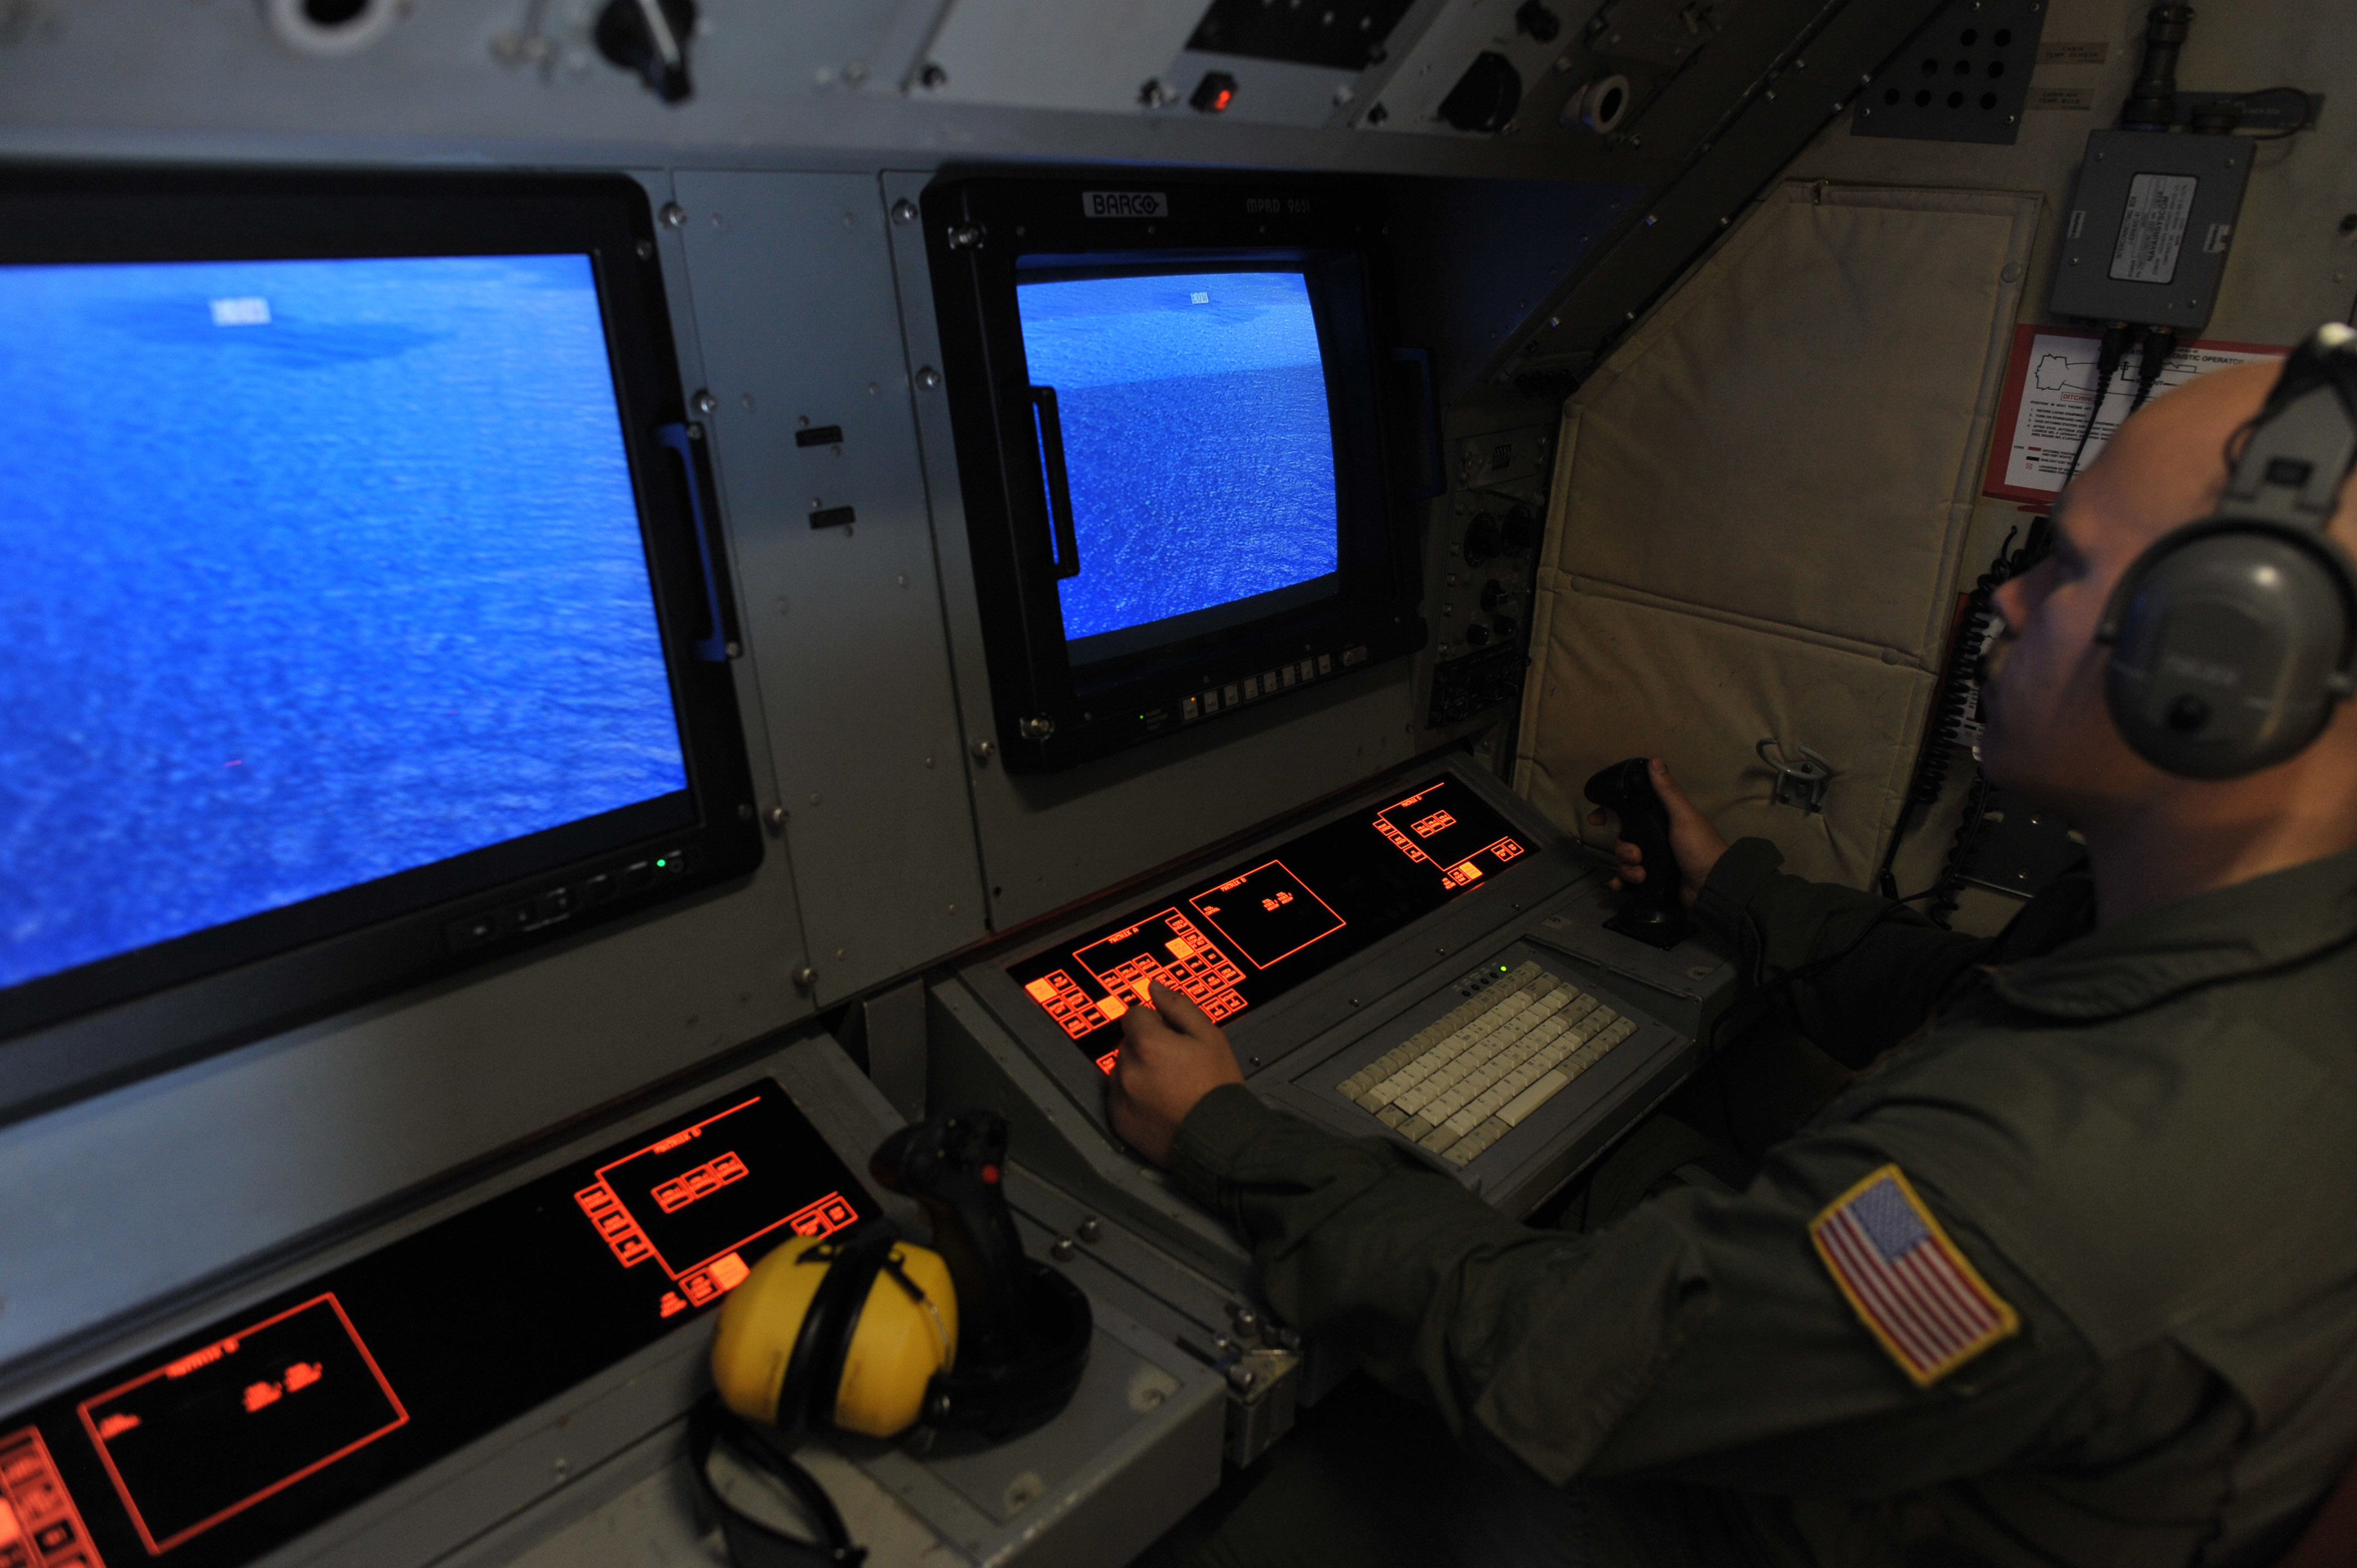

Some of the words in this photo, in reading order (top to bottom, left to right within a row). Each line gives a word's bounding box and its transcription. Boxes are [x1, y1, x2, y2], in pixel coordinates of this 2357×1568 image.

[1093, 194, 1159, 215] BARCO
[1247, 198, 1280, 213] MPRD
[1287, 199, 1310, 213] 9651
[2146, 195, 2170, 261] NAVAIRSYSCOM
[1219, 880, 1241, 892] MATRIX
[1108, 930, 1131, 943] MATRIX
